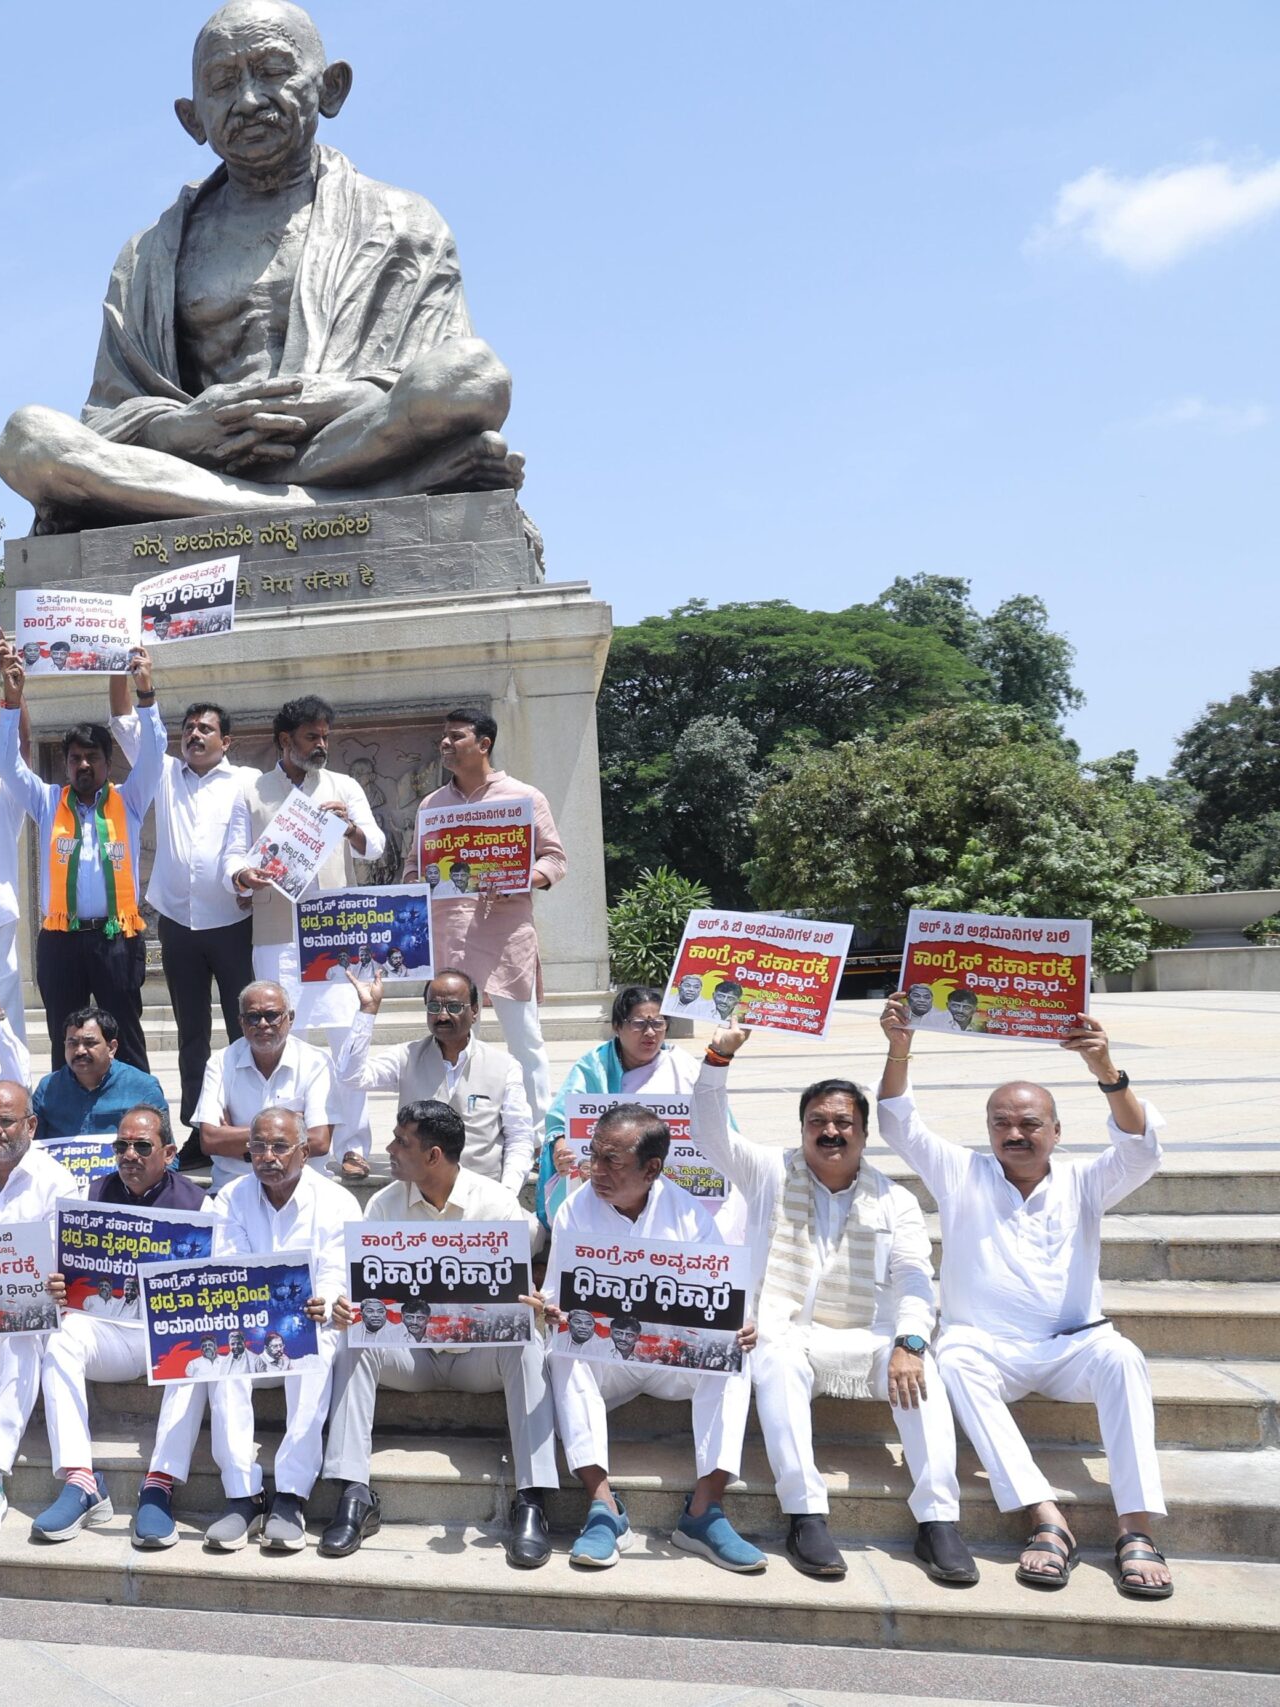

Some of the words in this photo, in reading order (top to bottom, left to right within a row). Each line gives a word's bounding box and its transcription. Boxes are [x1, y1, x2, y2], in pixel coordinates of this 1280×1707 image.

[133, 534, 169, 563] ನನ್ನ
[173, 524, 253, 552] ಜೀವನವೇ
[259, 521, 297, 551] ನನ್ನ
[302, 512, 370, 541] ಸಂದೇಶ
[261, 575, 294, 595] मेरा
[304, 569, 350, 592] संदेश
[358, 563, 375, 586] है
[23, 615, 71, 630] ಕಾಂಗ್ರೆಸ್
[75, 616, 129, 634] ಸರ್ಕಾರಕ್ಕೆ
[71, 633, 98, 647] ಧಿಕ್ಕಾರ
[300, 899, 336, 913] ಕಾಂಗ್ರೆಸ್
[338, 897, 378, 909] ಸರ್ಕಾರದ
[300, 915, 334, 931] ಭದ್ರತಾ
[336, 910, 395, 931] ವೈಫಲ್ಯದಿಂದ
[698, 918, 719, 931] ಆರ್
[721, 919, 729, 931] ಸಿ
[731, 921, 742, 933] ಬಿ
[744, 923, 812, 942] ಅಭಿಮಾನಿಗಳ
[814, 931, 834, 944] ಬಲಿ
[919, 920, 941, 934] ಆರ್
[942, 922, 951, 934] ಸಿ
[954, 923, 965, 936] ಬಿ
[967, 925, 1043, 942] ಅಭಿಮಾನಿಗಳ
[1046, 930, 1070, 943] ಬಲಿ
[302, 931, 368, 948] ಅಮಾಯಕರು
[370, 929, 392, 944] ಬಲಿ
[688, 943, 756, 967] ಕಾಂಗ್ರೆಸ್
[757, 953, 831, 984] ಸರ್ಕಾರಕ್ಕೆ
[913, 949, 983, 974] ಕಾಂಗ್ರೆಸ್
[987, 955, 1077, 987] ಸರ್ಕಾರಕ್ಕೆ
[734, 966, 774, 988] ಧಿಕ್ಕಾರ
[965, 972, 1009, 993] ಧಿಕ್ಕಾರ
[62, 1213, 103, 1229] ಕಾಂಗ್ರೆಸ್
[105, 1218, 153, 1234] ಸರ್ಕಾರದ
[61, 1228, 99, 1249] ಭದ್ರತಾ
[102, 1233, 172, 1259] ವೈಫಲ್ಯದಿಂದ
[361, 1231, 427, 1251] ಕಾಂಗ್ರೆಸ್
[431, 1231, 509, 1256] ಅವ್ಯವಸ್ಥೆಗೆ
[62, 1252, 137, 1277] ಅಮಾಯಕರು
[575, 1244, 645, 1265] ಕಾಂಗ್ರೆಸ್
[650, 1252, 730, 1280] ಅವ್ಯವಸ್ಥೆಗೆ
[148, 1272, 196, 1291] ಕಾಂಗ್ರೆಸ್
[197, 1269, 248, 1286] ಸರ್ಕಾರದ
[362, 1256, 435, 1296] ಧಿಕ್ಕಾರ
[438, 1256, 514, 1296] ಧಿಕ್ಕಾರ
[149, 1293, 194, 1314] ಭದ್ರತಾ
[197, 1284, 271, 1313] ವೈಫಲ್ಯದಿಂದ
[573, 1266, 650, 1313] ಧಿಕ್ಕಾರ
[654, 1275, 732, 1322] ಧಿಕ್ಕಾರ
[153, 1311, 240, 1336] ಅಮಾಯಕರು
[243, 1309, 270, 1328] ಬಲಿ
